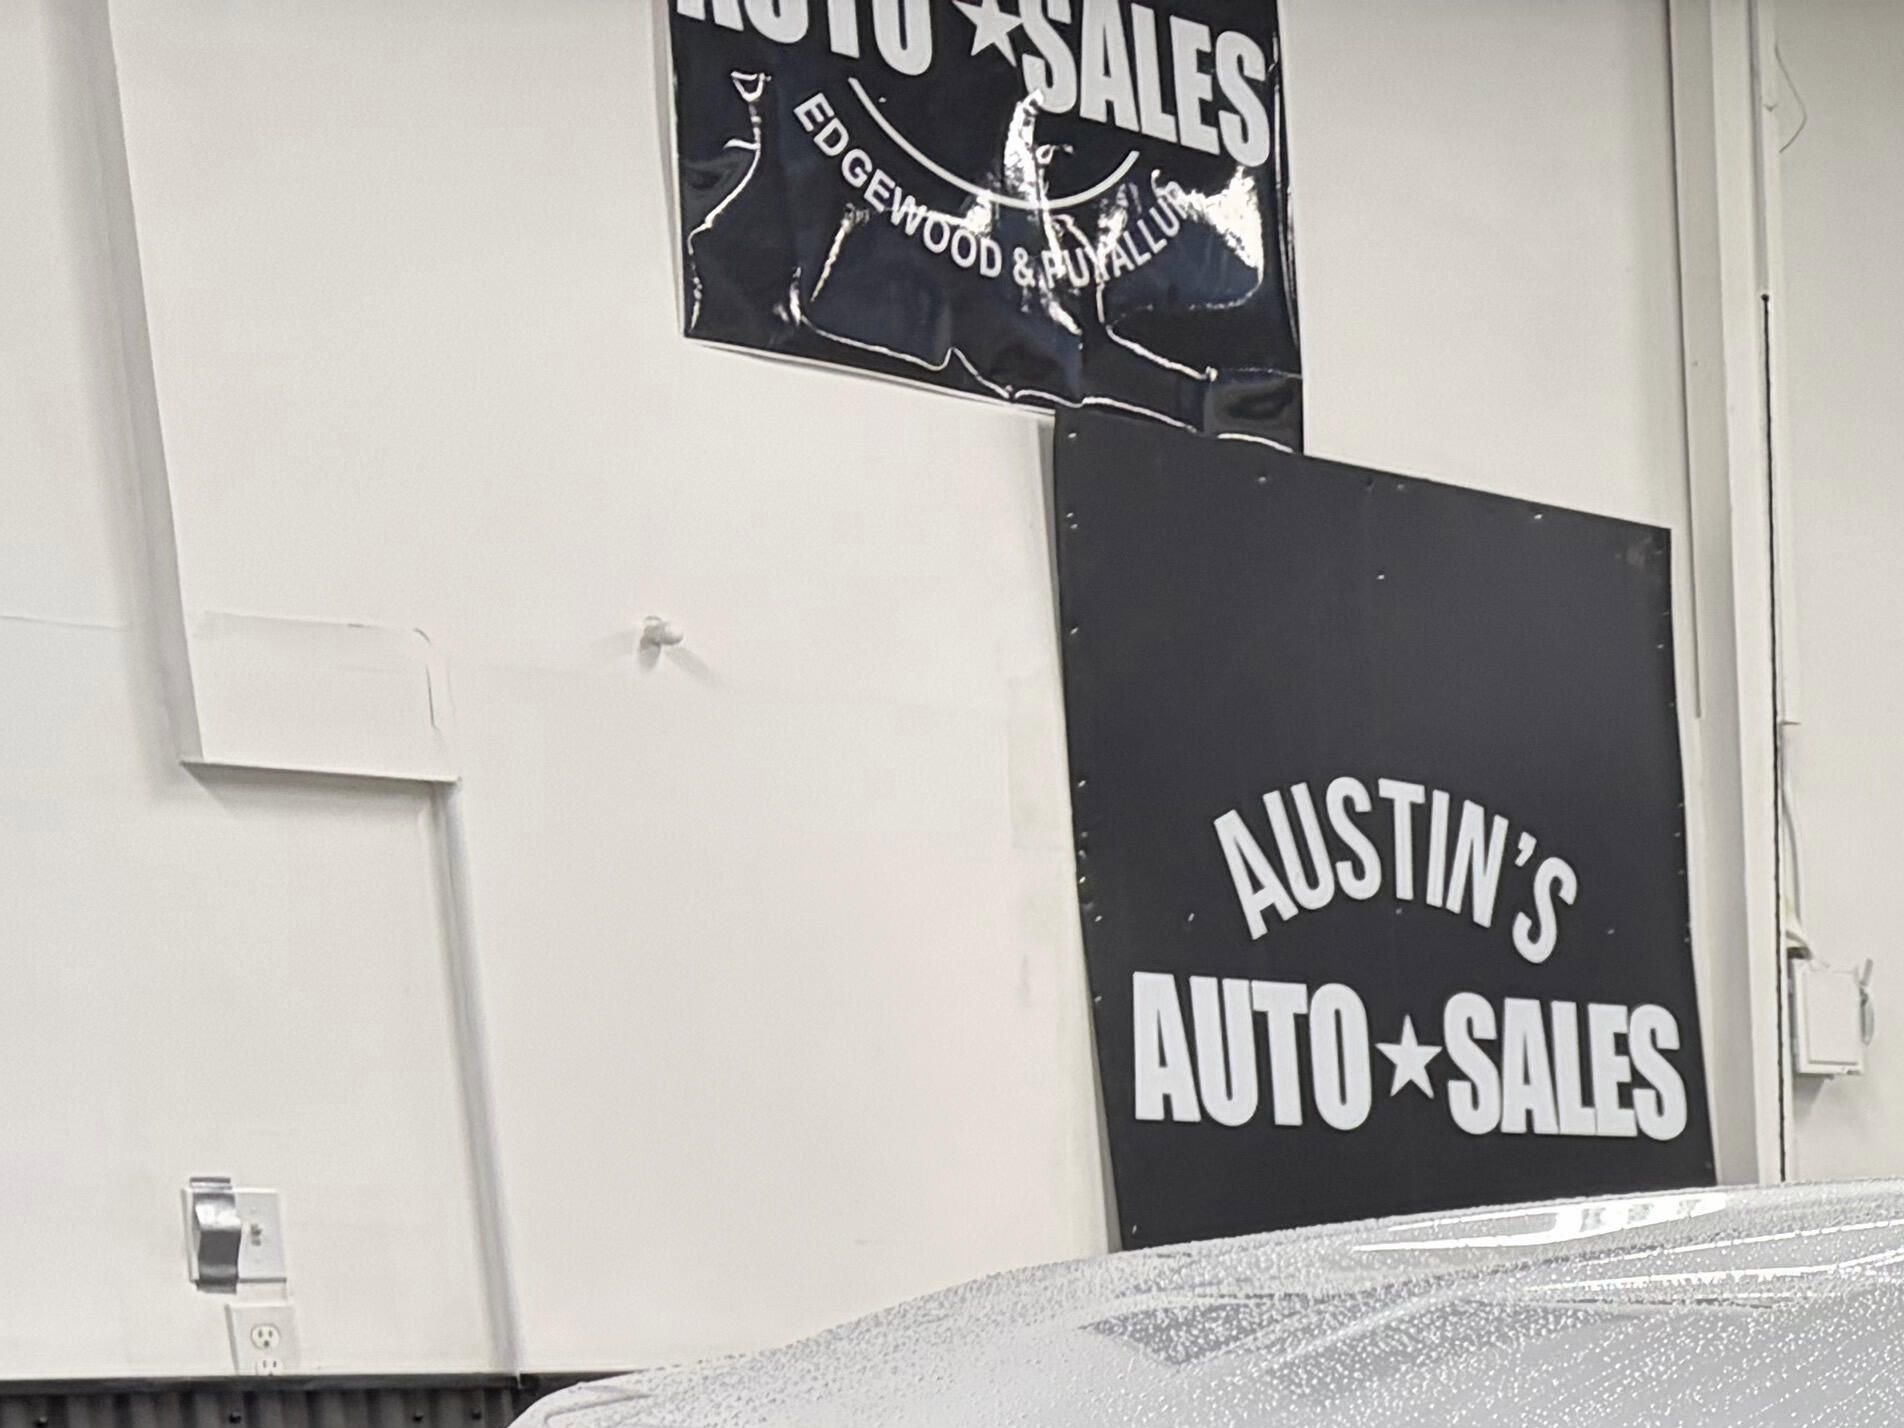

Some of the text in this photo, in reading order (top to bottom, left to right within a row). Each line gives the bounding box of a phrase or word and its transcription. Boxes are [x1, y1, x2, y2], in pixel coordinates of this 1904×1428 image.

[1020, 0, 1270, 167] SALES
[793, 92, 1001, 278] EDGEWOOD
[1013, 247, 1036, 288] &
[1214, 776, 1577, 964] AUSTIN'S
[1132, 971, 1688, 1141] AUTO SALES
